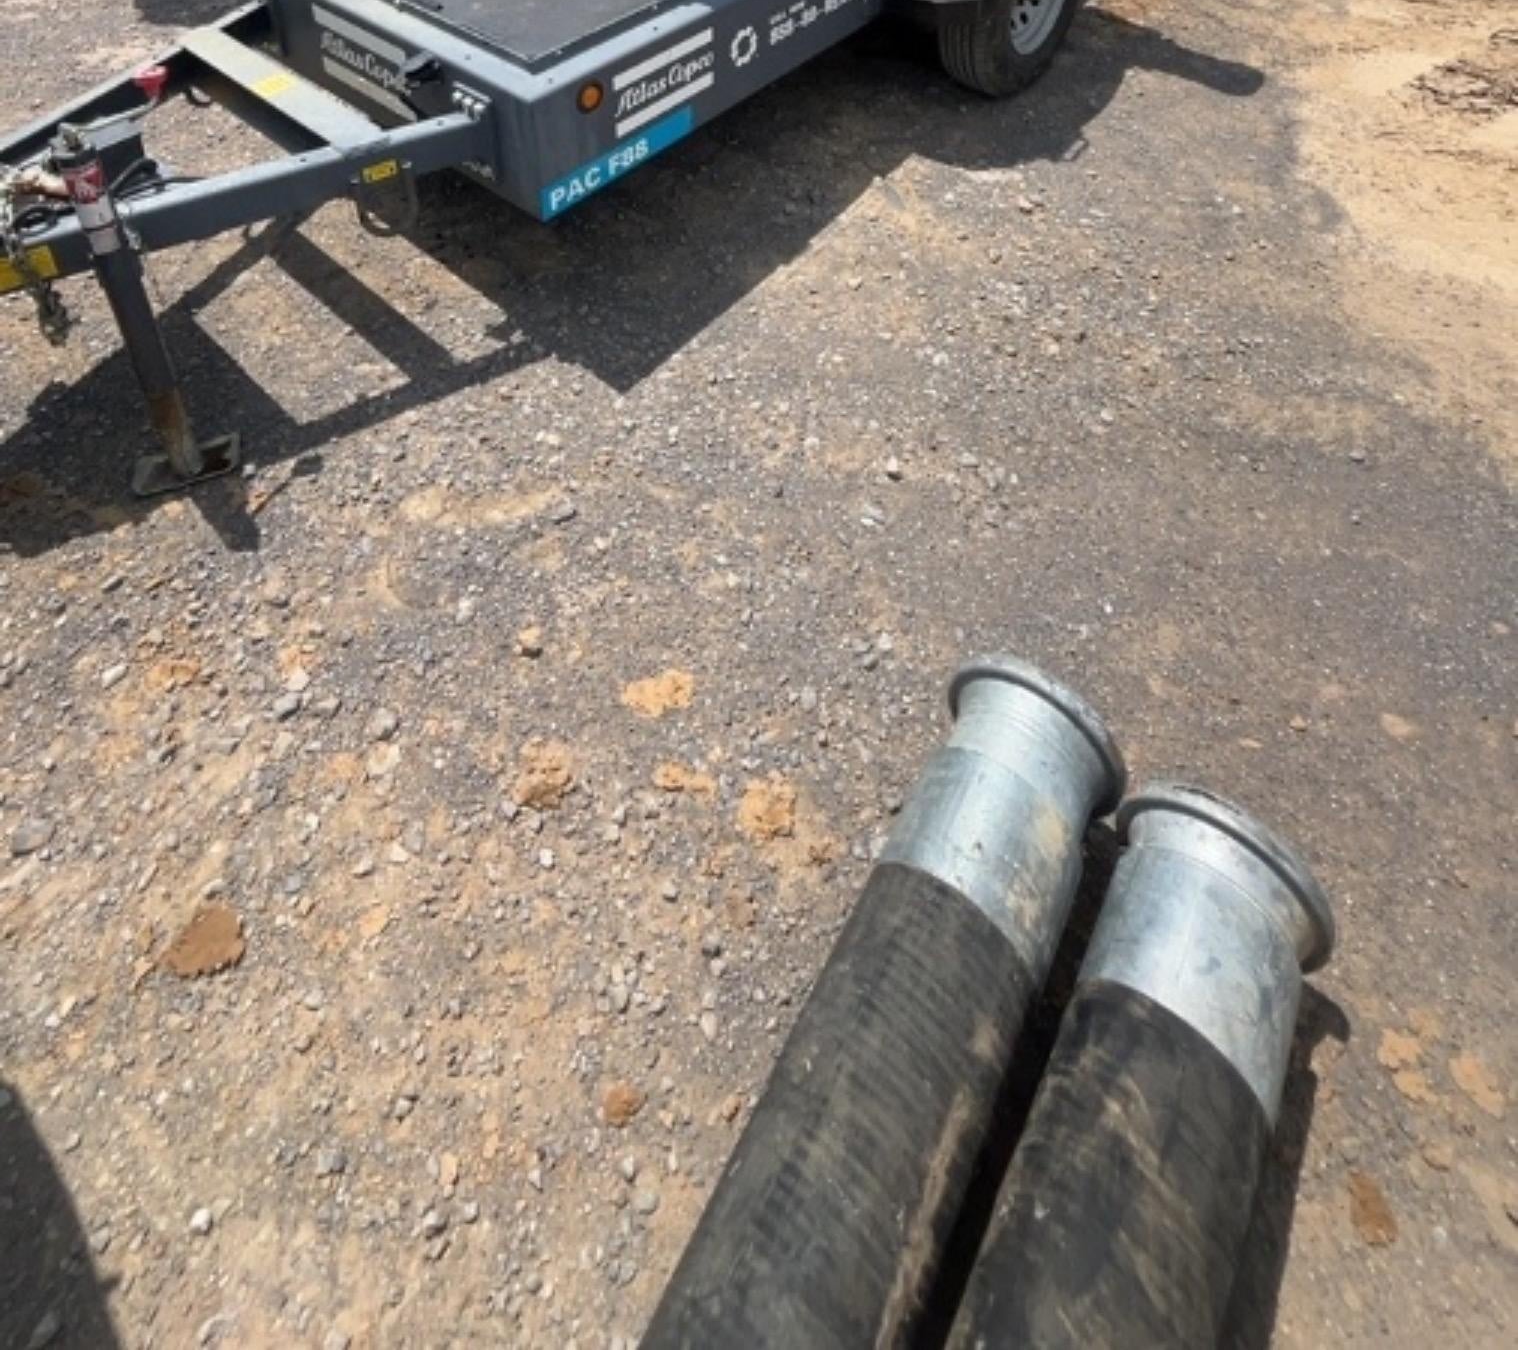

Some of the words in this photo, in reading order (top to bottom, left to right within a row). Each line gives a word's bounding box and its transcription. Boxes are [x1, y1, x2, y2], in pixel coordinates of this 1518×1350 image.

[614, 80, 667, 118] Atlas
[668, 51, 715, 86] Copco
[550, 166, 601, 211] PAC
